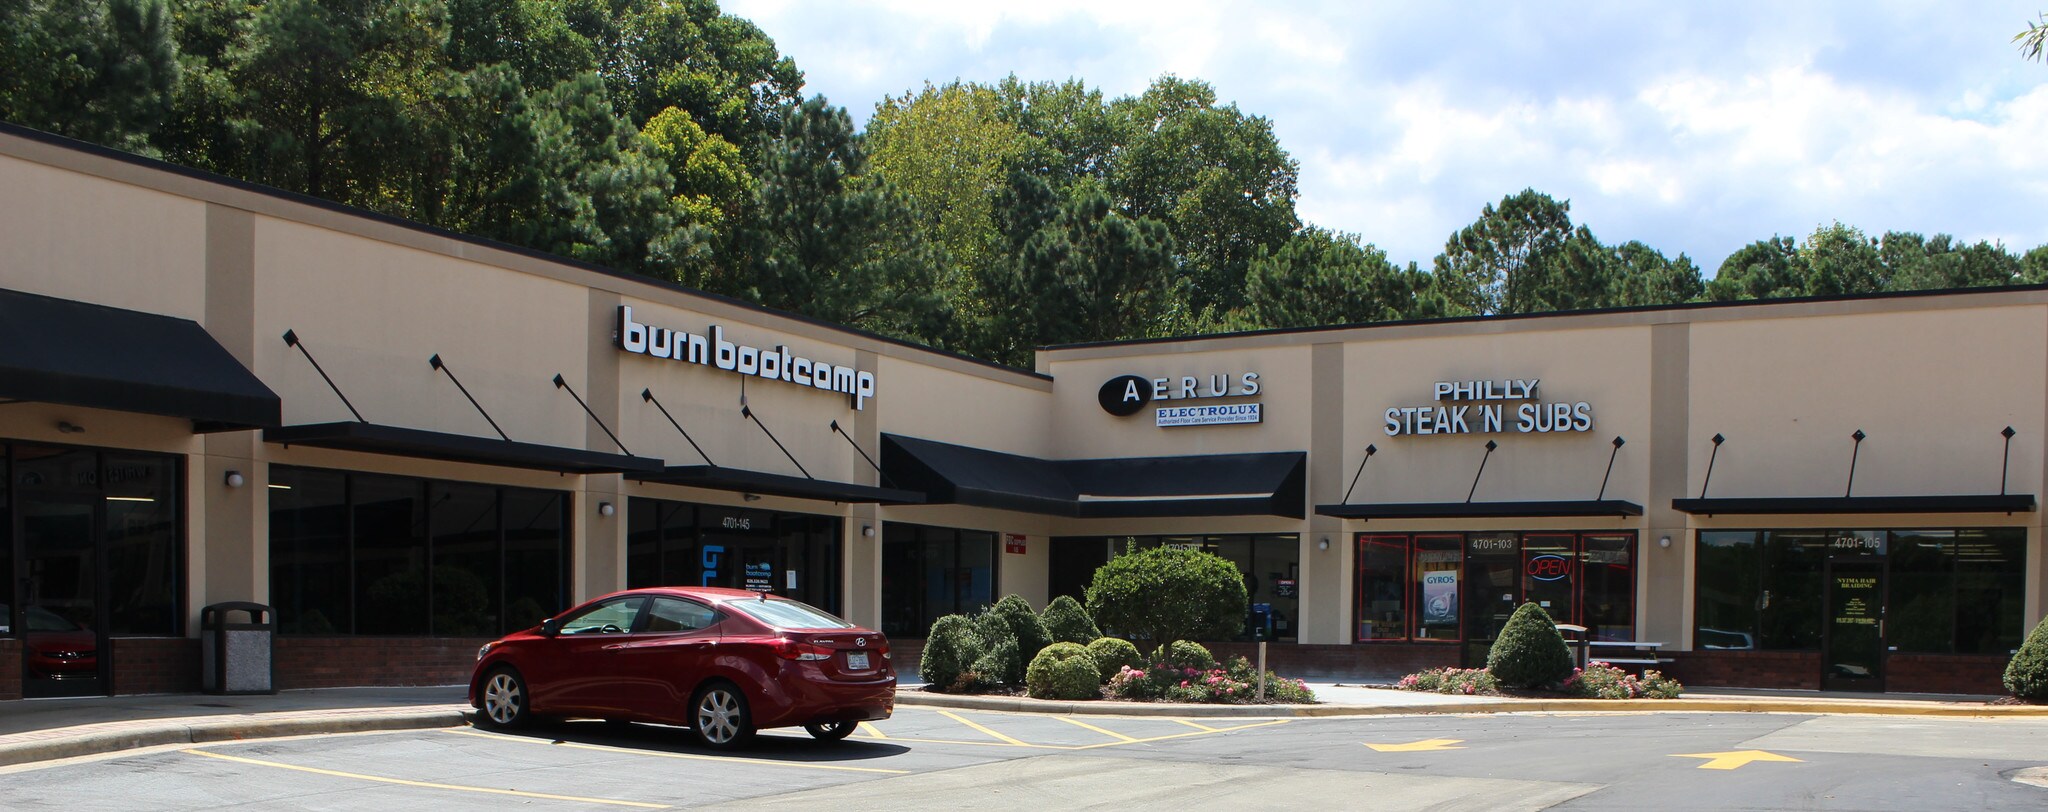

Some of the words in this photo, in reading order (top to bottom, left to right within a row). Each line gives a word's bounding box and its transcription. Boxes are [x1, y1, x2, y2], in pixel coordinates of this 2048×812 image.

[621, 305, 708, 365] burn
[711, 325, 875, 410] bootcamp
[1122, 372, 1260, 402] AERUS
[1434, 379, 1538, 401] PHILLY
[1158, 404, 1257, 418] ELECTROLUX
[1383, 405, 1470, 437] STEAK
[1517, 402, 1592, 433] SUBS
[722, 517, 750, 530] 4701-145
[1472, 538, 1512, 550] 4701-103
[1834, 537, 1880, 548] 4701-105
[745, 569, 772, 579] bootcamp
[1527, 559, 1572, 575] OPEN
[1426, 576, 1455, 584] GYROS
